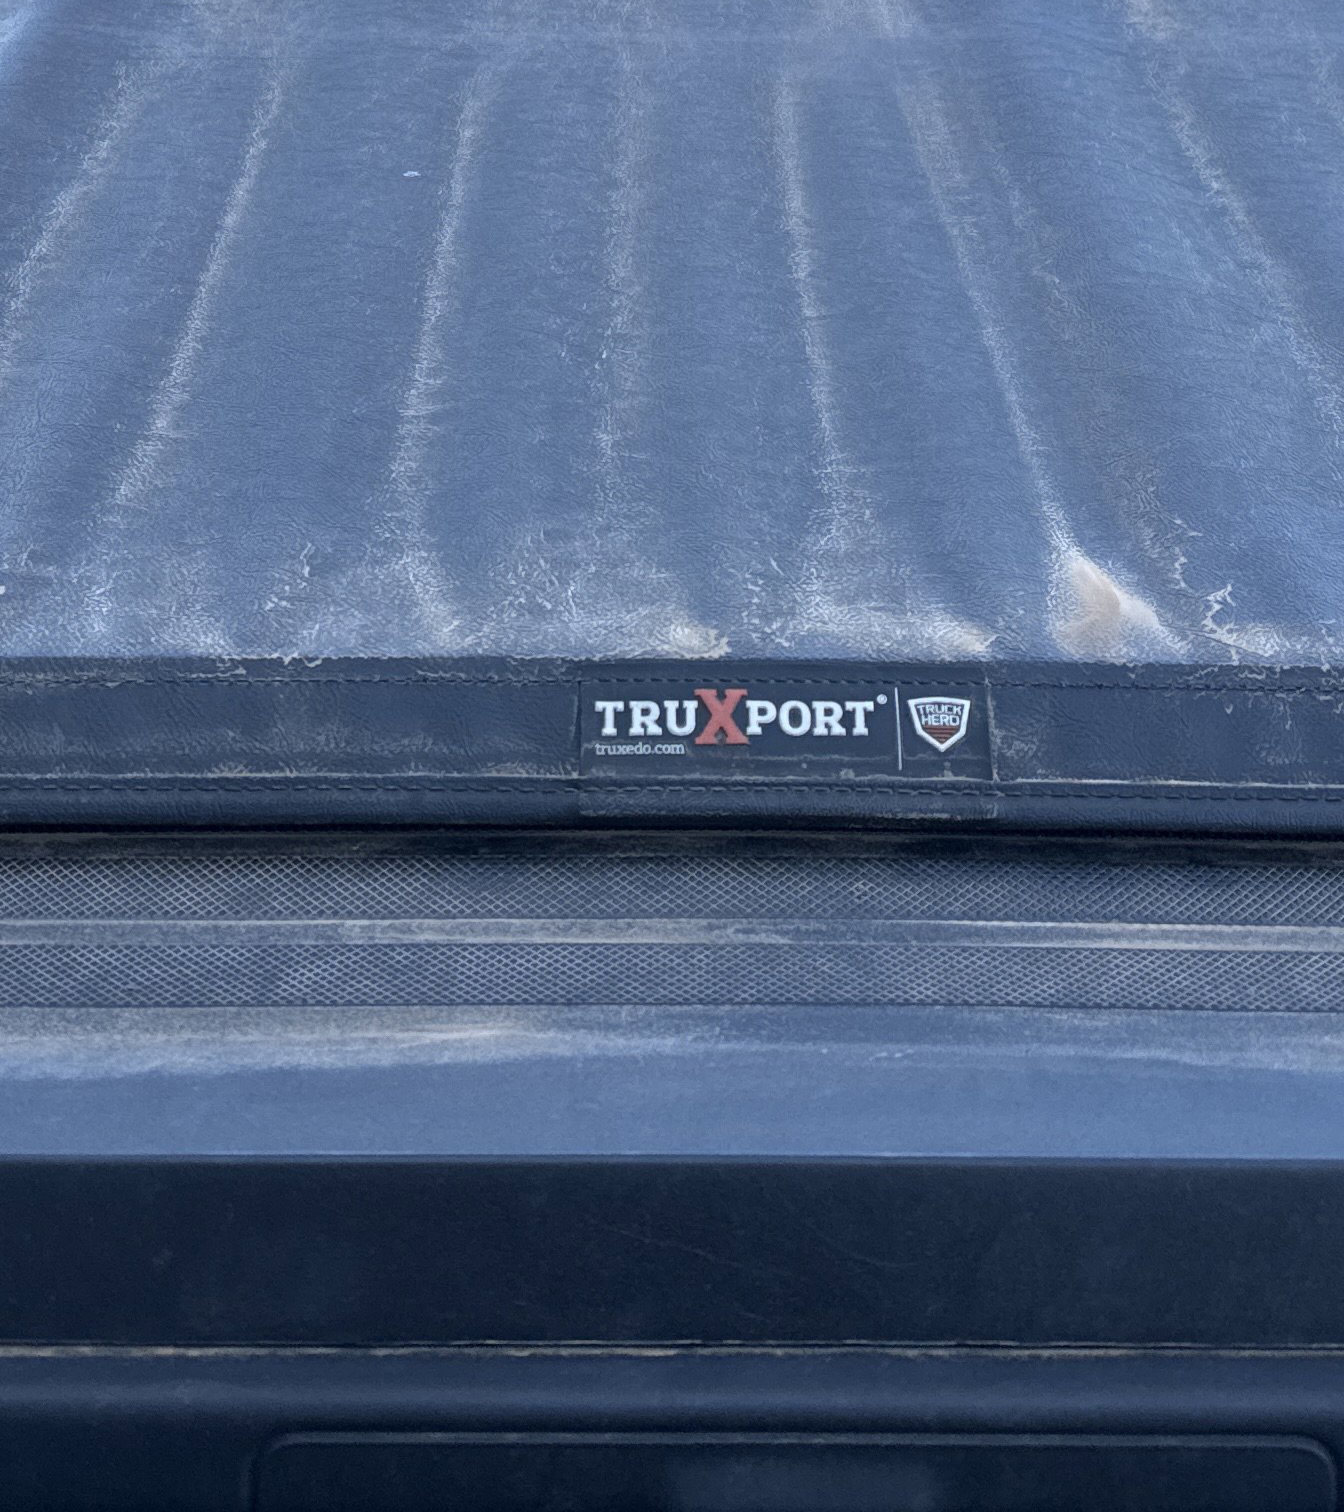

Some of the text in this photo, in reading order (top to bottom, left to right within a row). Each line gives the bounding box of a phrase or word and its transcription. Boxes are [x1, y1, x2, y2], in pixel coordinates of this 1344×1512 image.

[916, 703, 962, 716] TRUCK
[921, 714, 960, 726] HERD
[594, 742, 686, 756] truxedo.com
